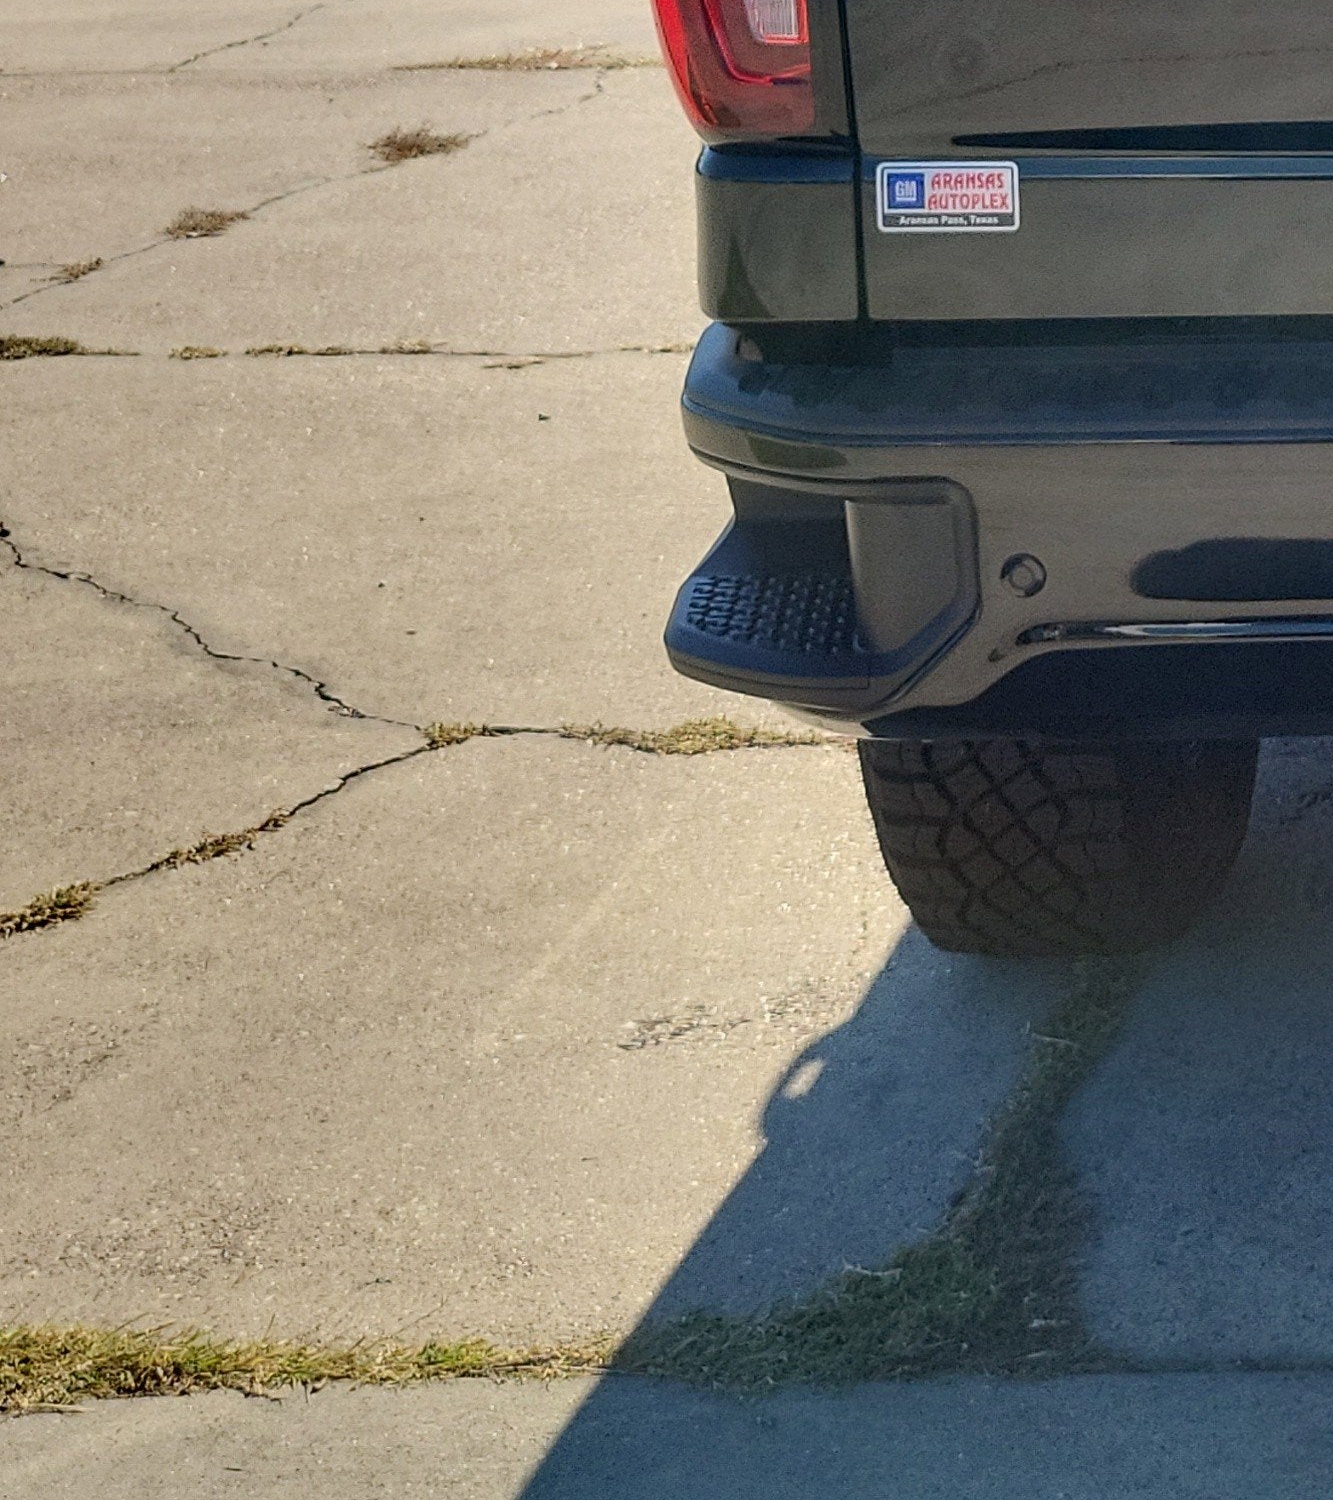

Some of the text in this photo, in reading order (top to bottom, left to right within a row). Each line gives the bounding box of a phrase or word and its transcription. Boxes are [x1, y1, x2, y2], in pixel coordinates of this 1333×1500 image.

[931, 172, 1005, 190] ARANSAS
[895, 180, 918, 201] GM
[928, 192, 1009, 210] AUTOPLEX
[970, 215, 999, 224] Texas
